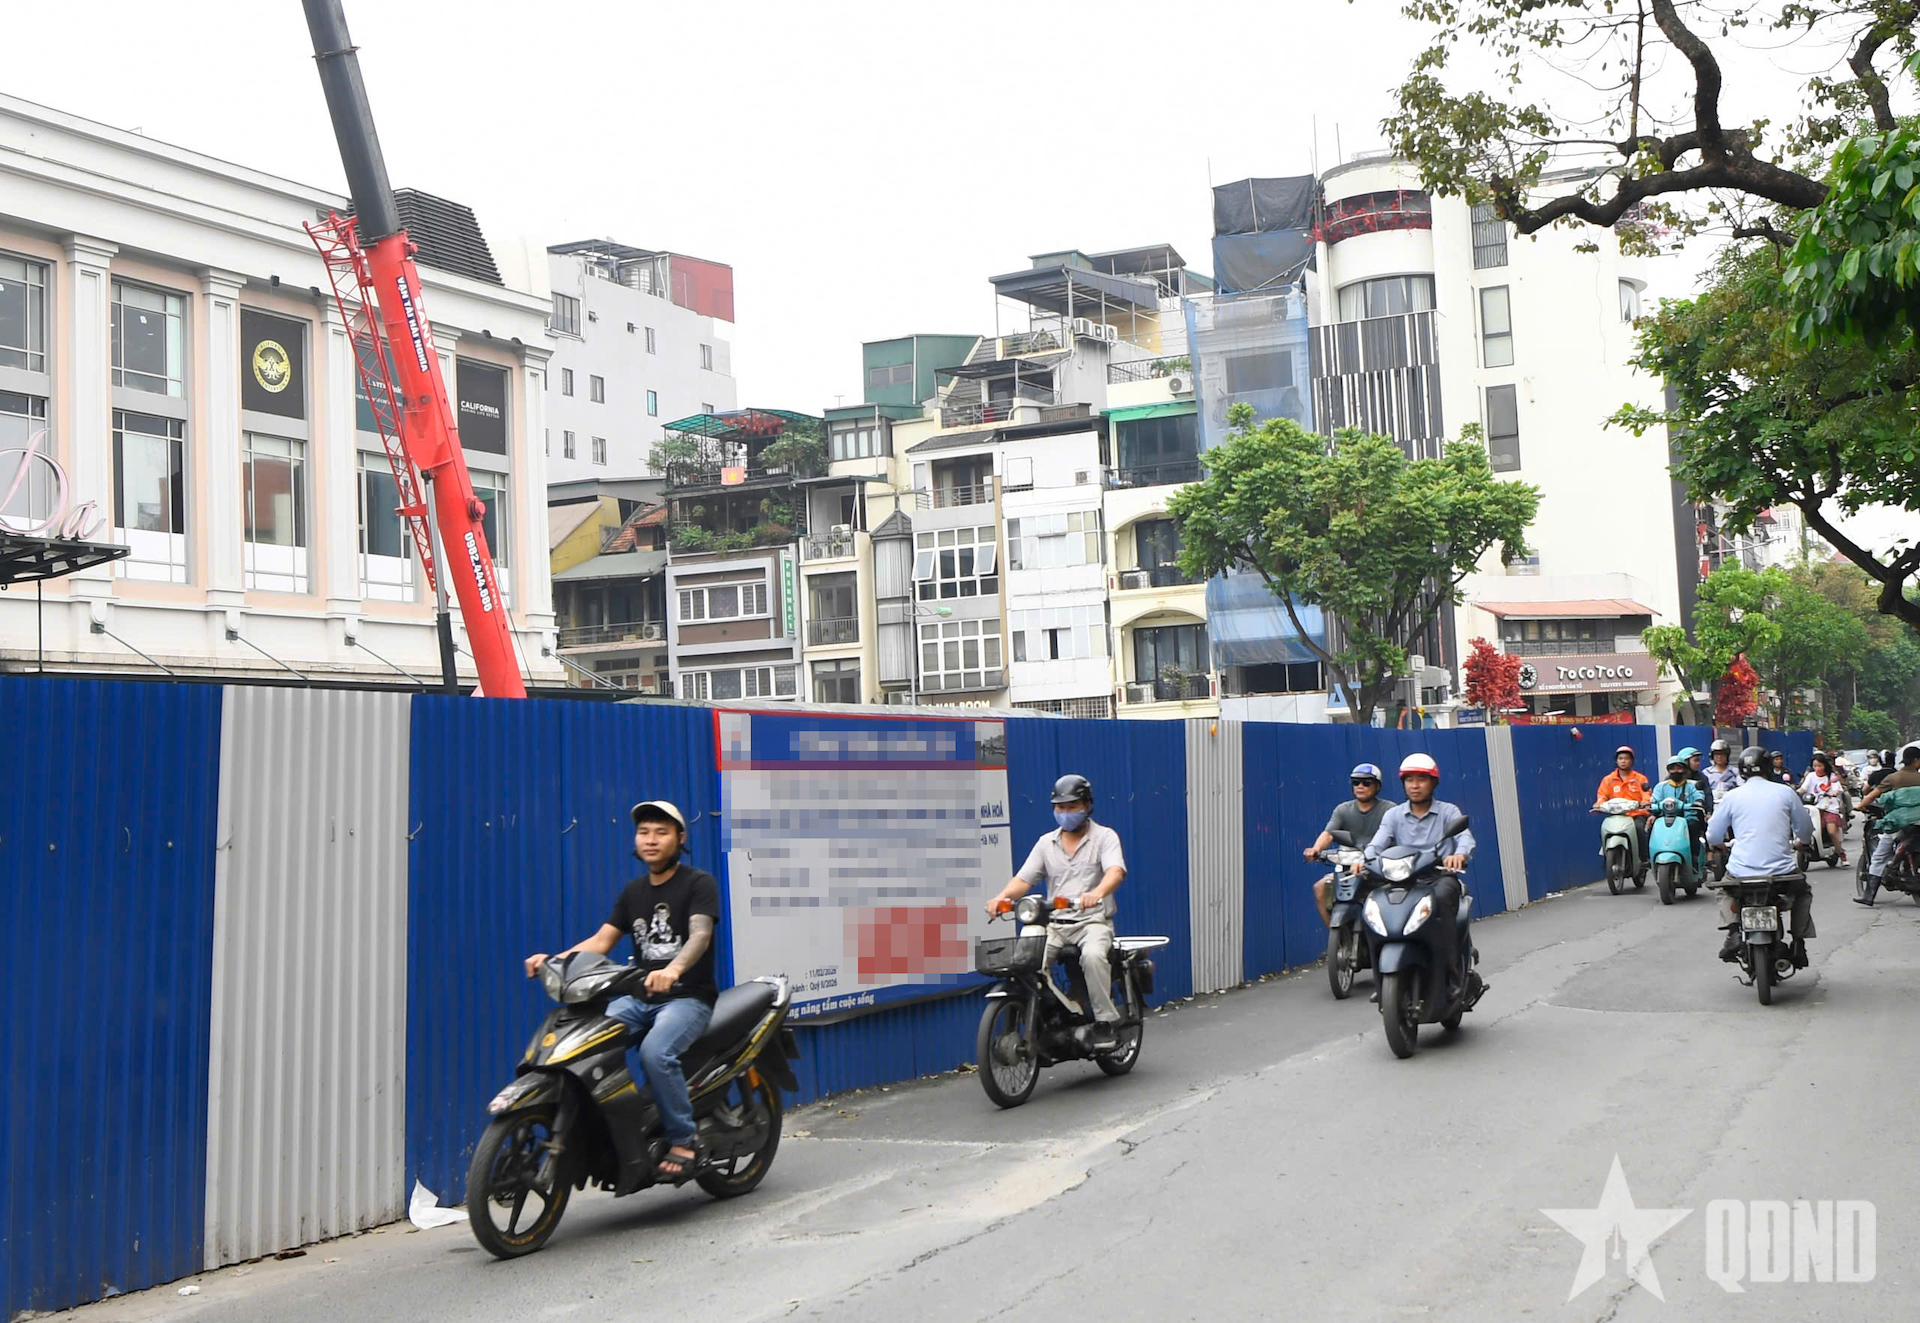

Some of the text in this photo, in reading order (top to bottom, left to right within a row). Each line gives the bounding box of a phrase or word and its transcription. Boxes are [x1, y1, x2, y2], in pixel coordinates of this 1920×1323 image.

[460, 400, 500, 415] CALIFORNIA
[785, 562, 793, 630] PHARMACY
[839, 995, 857, 1009] cuộc
[857, 991, 875, 1005] sống
